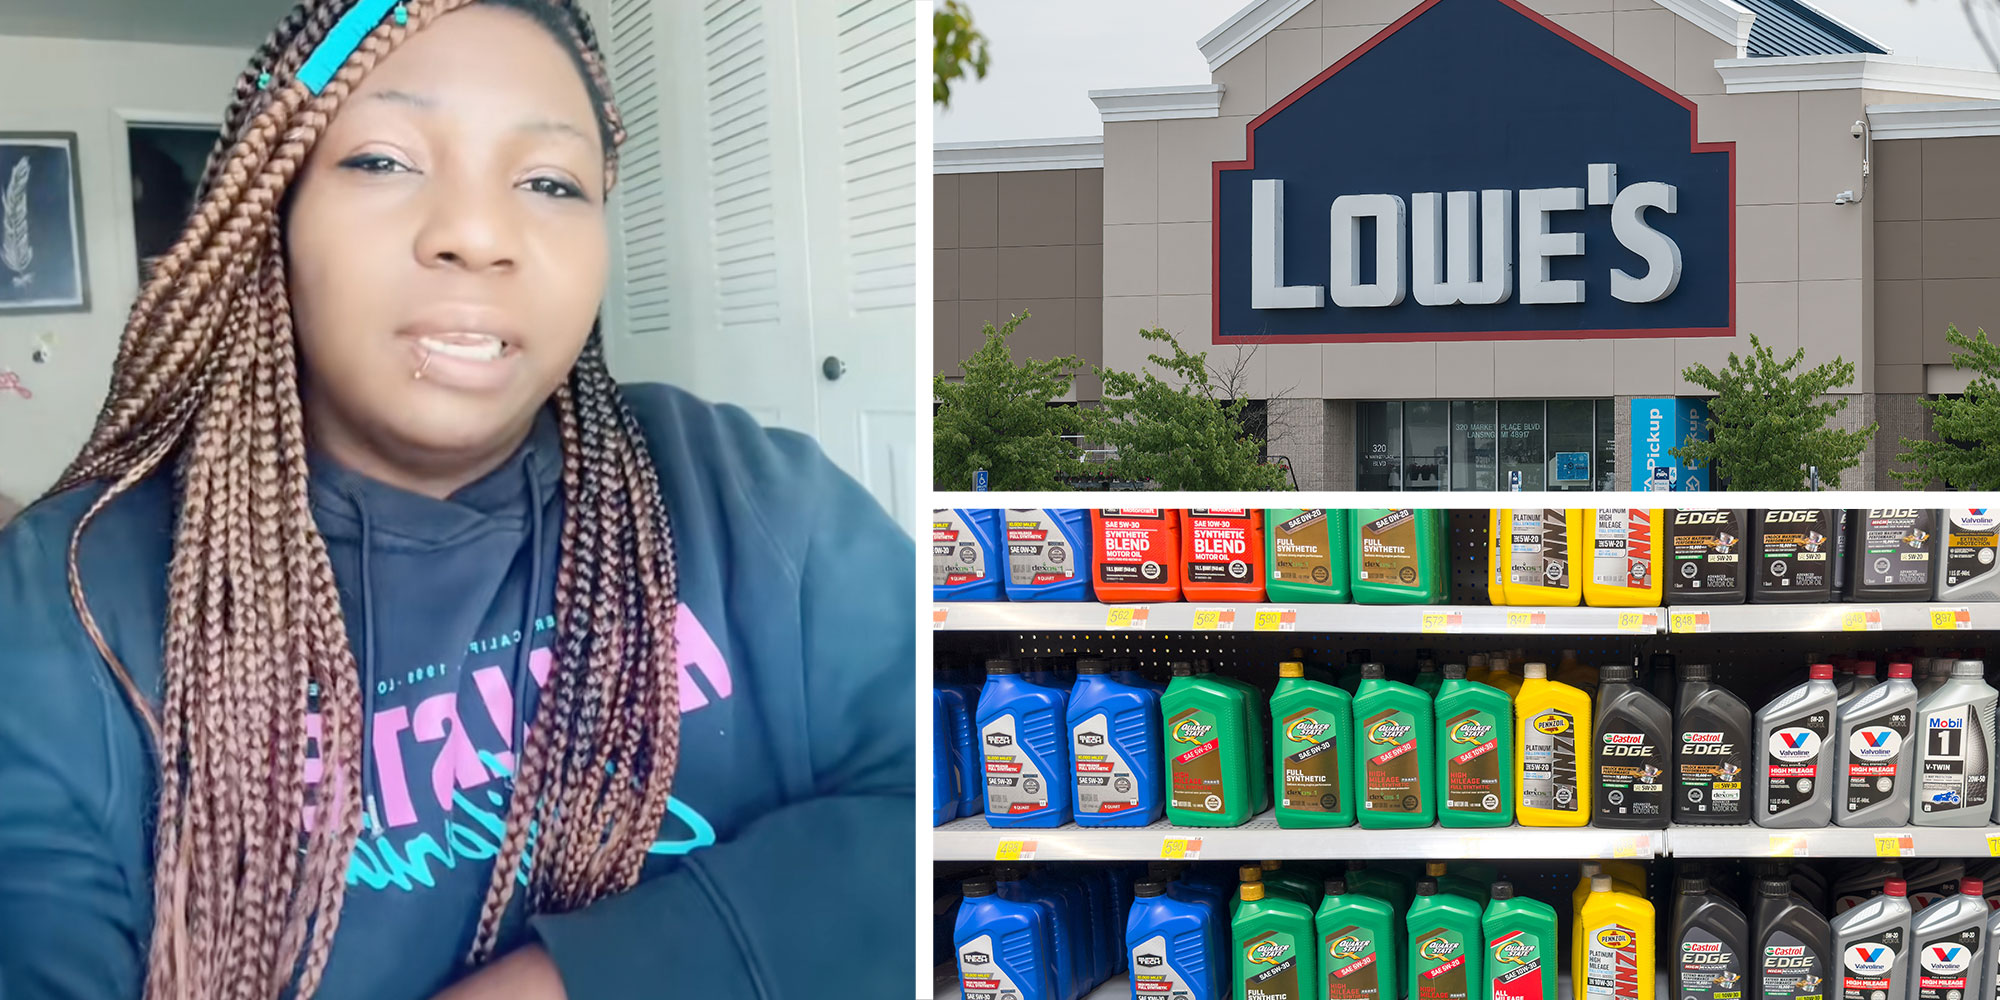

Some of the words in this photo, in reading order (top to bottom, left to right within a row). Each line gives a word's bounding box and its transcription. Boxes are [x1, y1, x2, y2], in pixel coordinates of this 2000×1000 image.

[1252, 163, 1682, 309] LOWE'S
[1647, 408, 1663, 471] Pickup
[1372, 444, 1386, 452] 320
[1288, 516, 1302, 529] SAE
[1300, 509, 1321, 523] 0W-20
[1376, 516, 1389, 529] SAE
[1388, 509, 1409, 523] 0W-20
[1674, 512, 1730, 524] EDGE
[1765, 511, 1820, 523] EDGE
[1869, 509, 1919, 518] EDGE
[1194, 530, 1244, 539] SYNTHETIC
[1106, 539, 1150, 551] BLEND
[1194, 540, 1246, 553] BLEND
[1538, 720, 1565, 728] PENNZOIL
[1929, 718, 1962, 728] Mobil
[1613, 735, 1641, 743] Castrol
[1692, 734, 1721, 742] Castrol
[1938, 730, 1950, 755] 1
[1183, 752, 1194, 761] SAE
[1195, 743, 1212, 756] 5W-20
[1299, 750, 1311, 760] SAE
[1312, 742, 1330, 754] 5W-30
[1380, 752, 1393, 762] SAE
[1393, 743, 1411, 756] 5W-30
[1460, 752, 1472, 762] SAE
[1472, 742, 1493, 756] 10W-30
[1602, 746, 1655, 757] EDGE
[1682, 744, 1734, 755] EDGE
[1968, 775, 1986, 783] 20W-50
[1691, 943, 1719, 951] Castrol
[1774, 947, 1802, 955] Castrol
[1590, 950, 1614, 958] PLATINUM
[1682, 953, 1732, 963] EDGE
[1341, 967, 1353, 975] SAE
[1353, 957, 1371, 969] 5W-30
[1430, 968, 1442, 977] SAE
[1442, 959, 1460, 971] 5W-20
[1764, 956, 1815, 968] EDGE
[1259, 971, 1271, 980] SAE
[1272, 961, 1290, 974] 5W-30
[1504, 971, 1516, 980] SAE
[1517, 962, 1537, 975] 10W-30
